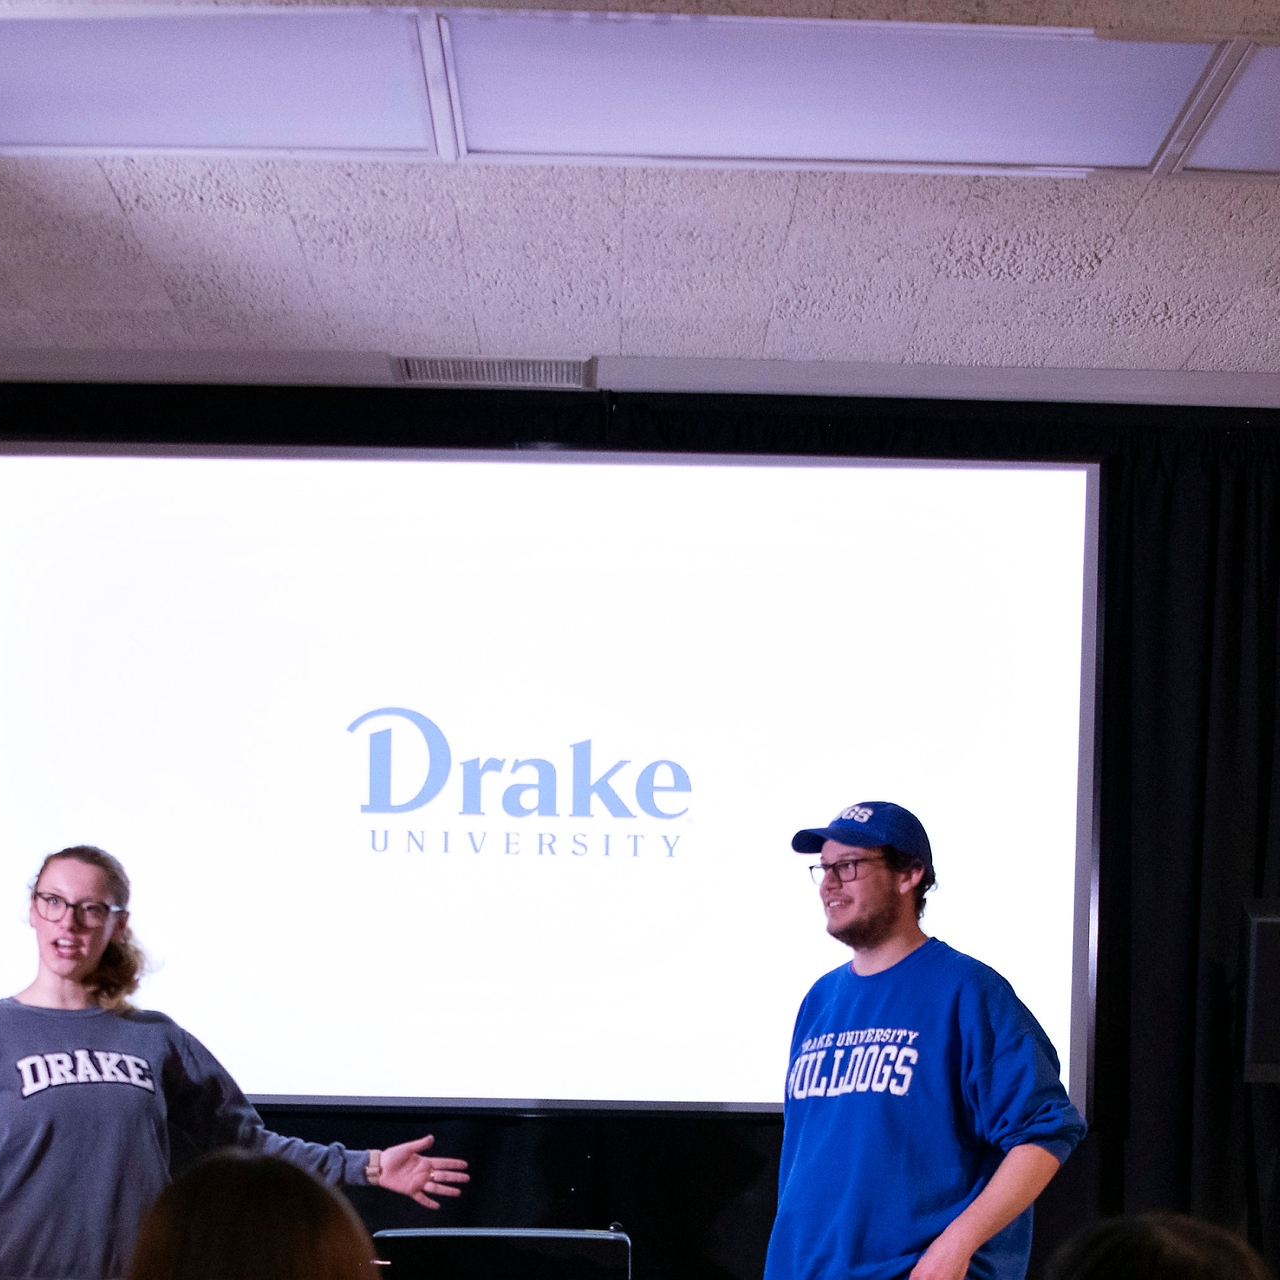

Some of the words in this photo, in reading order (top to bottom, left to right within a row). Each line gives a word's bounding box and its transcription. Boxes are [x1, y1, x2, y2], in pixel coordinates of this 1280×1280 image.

[346, 707, 692, 819] Drake
[370, 829, 681, 858] UNIVERSITY
[801, 1032, 835, 1053] RAKE
[836, 1028, 919, 1047] UNIVERSITY
[17, 1049, 156, 1098] DRAKE
